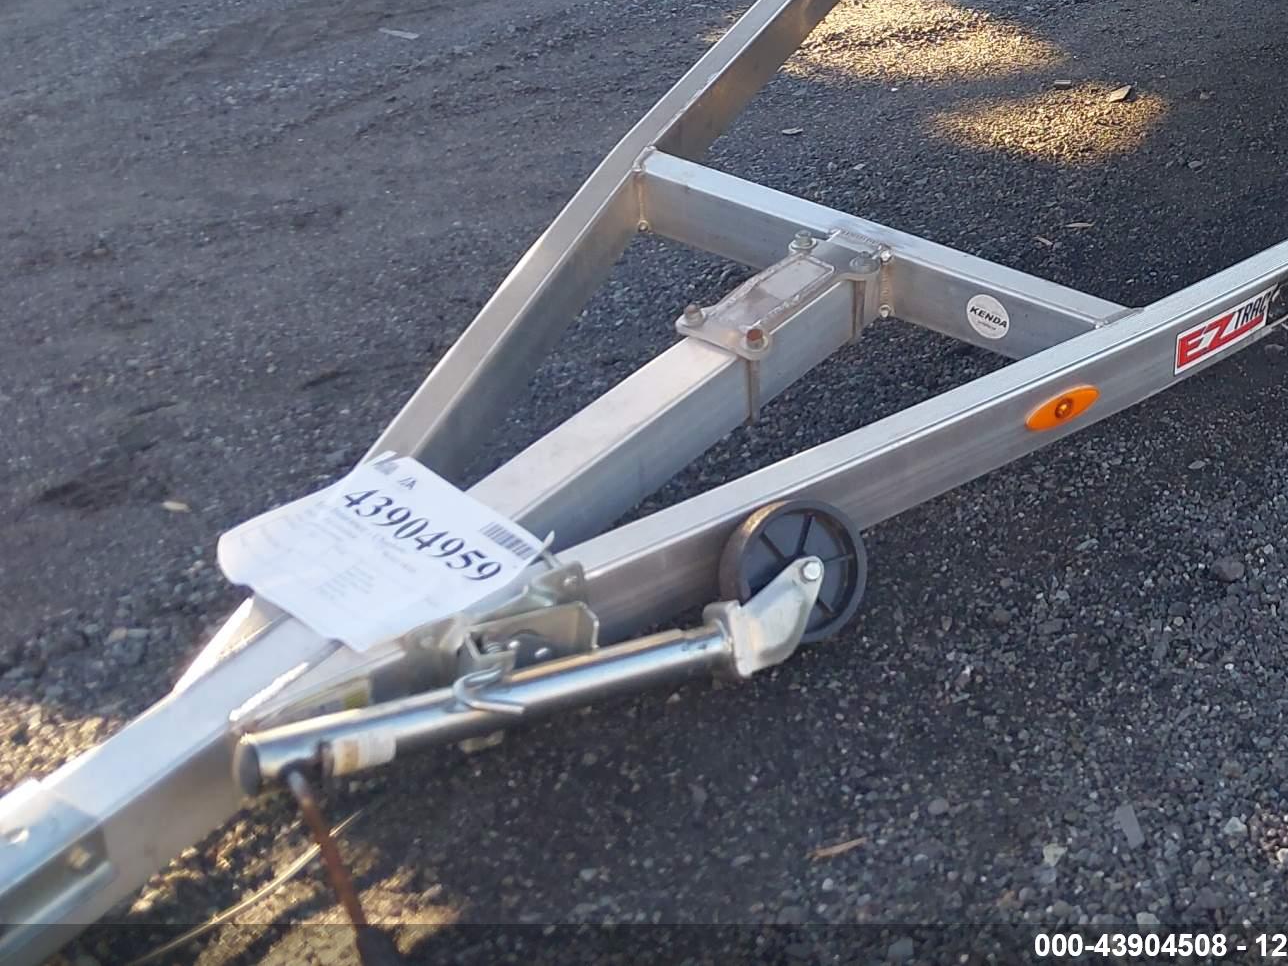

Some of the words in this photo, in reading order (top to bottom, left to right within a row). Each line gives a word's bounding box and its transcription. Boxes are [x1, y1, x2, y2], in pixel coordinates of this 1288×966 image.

[970, 305, 1007, 328] KENDA
[1177, 314, 1264, 369] EZ
[343, 489, 502, 581] 43904959
